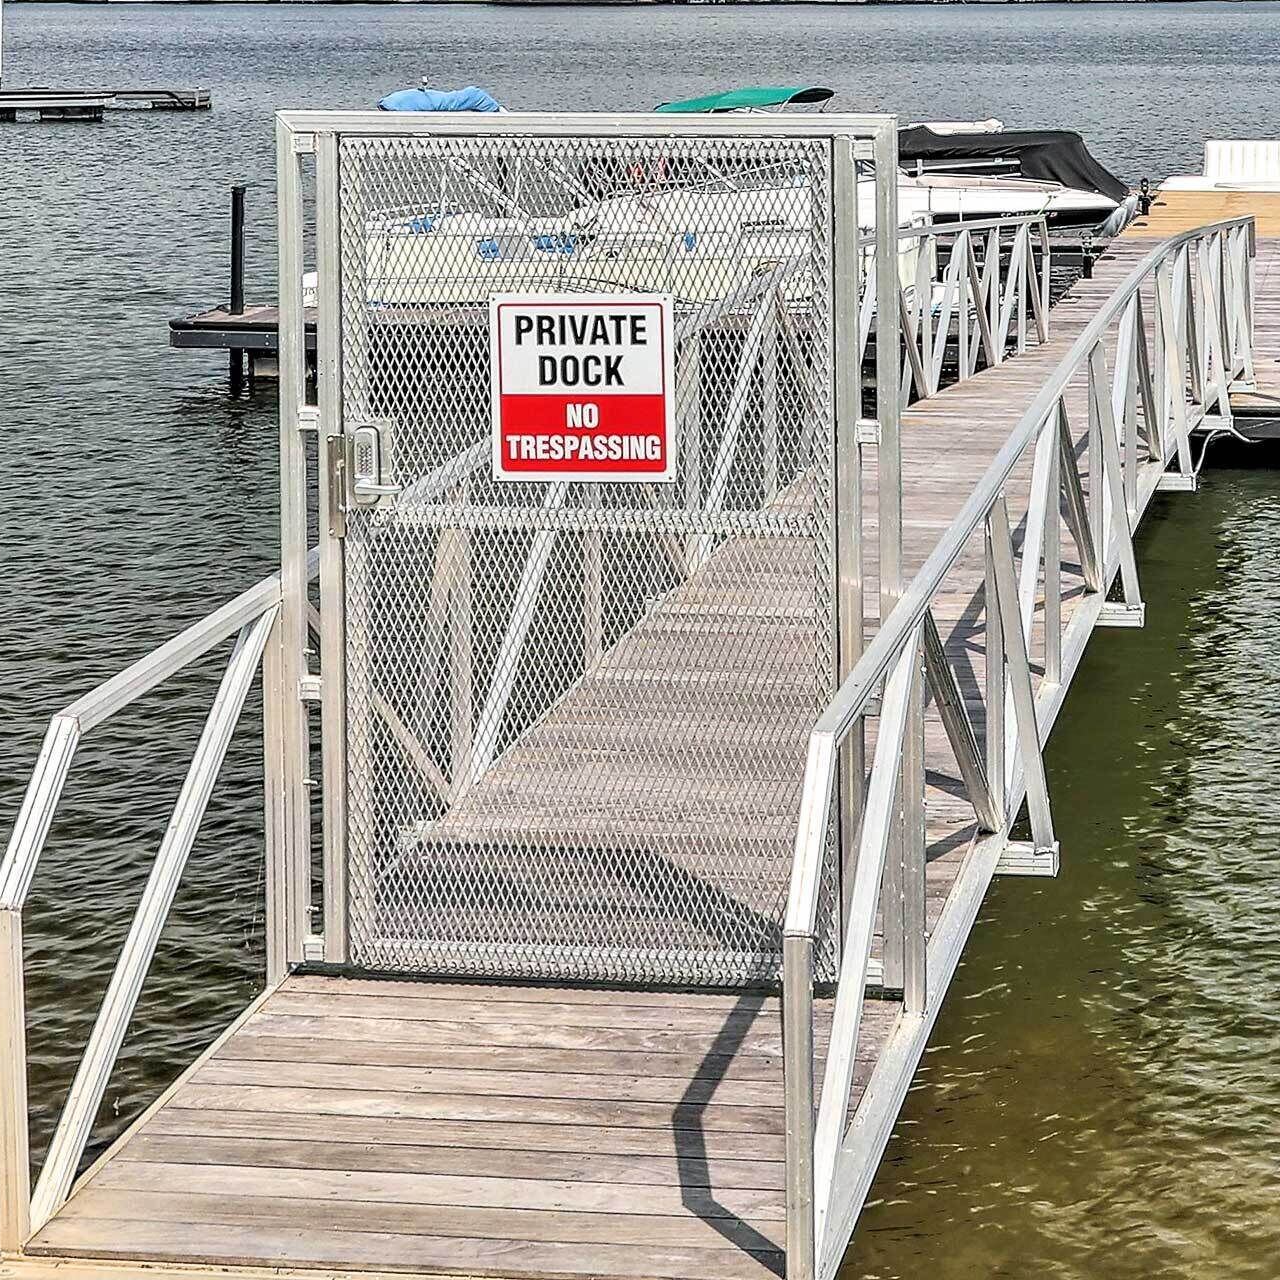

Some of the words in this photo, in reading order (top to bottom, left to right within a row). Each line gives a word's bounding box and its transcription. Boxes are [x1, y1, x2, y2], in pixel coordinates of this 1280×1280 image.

[514, 315, 648, 346] PRIVATE
[538, 355, 625, 387] DOCK
[566, 403, 600, 429] NO
[505, 434, 662, 461] TRESPASSING
